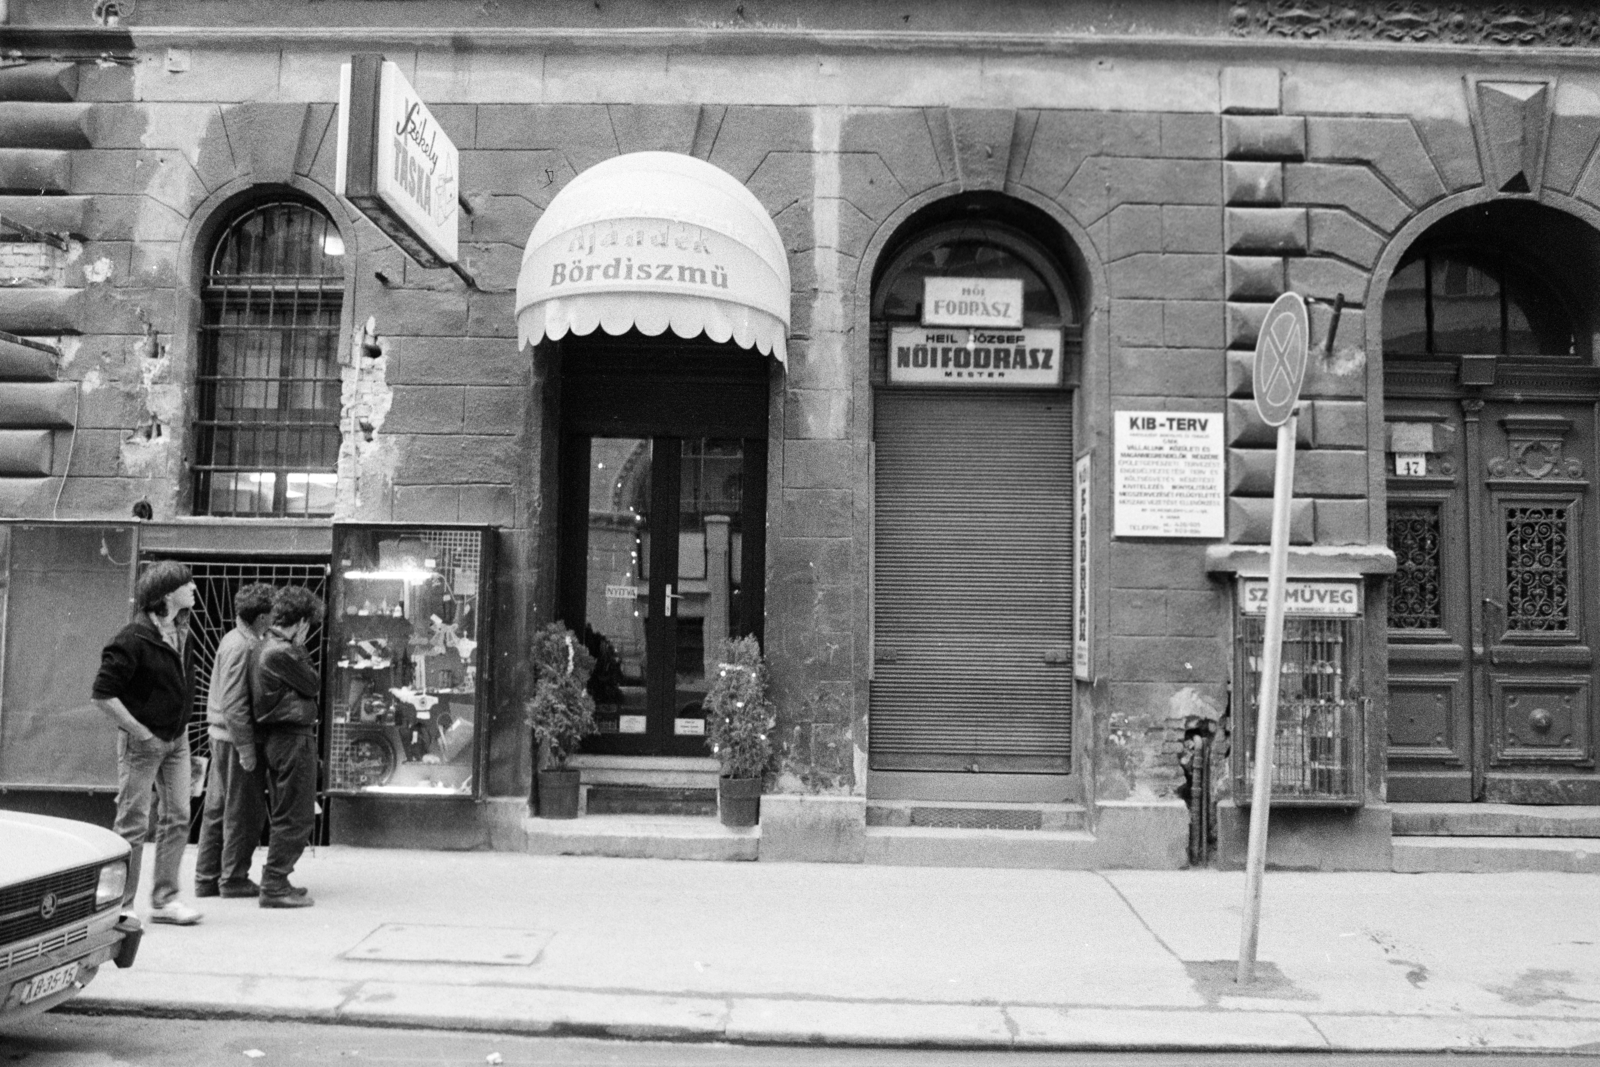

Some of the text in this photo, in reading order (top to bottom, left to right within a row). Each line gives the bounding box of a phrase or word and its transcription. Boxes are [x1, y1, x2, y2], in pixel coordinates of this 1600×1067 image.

[396, 102, 438, 175] Székely
[934, 297, 1012, 318] FODRÁSZ
[926, 334, 958, 344] HEIL
[1249, 584, 1353, 604] SZMÜVEG
